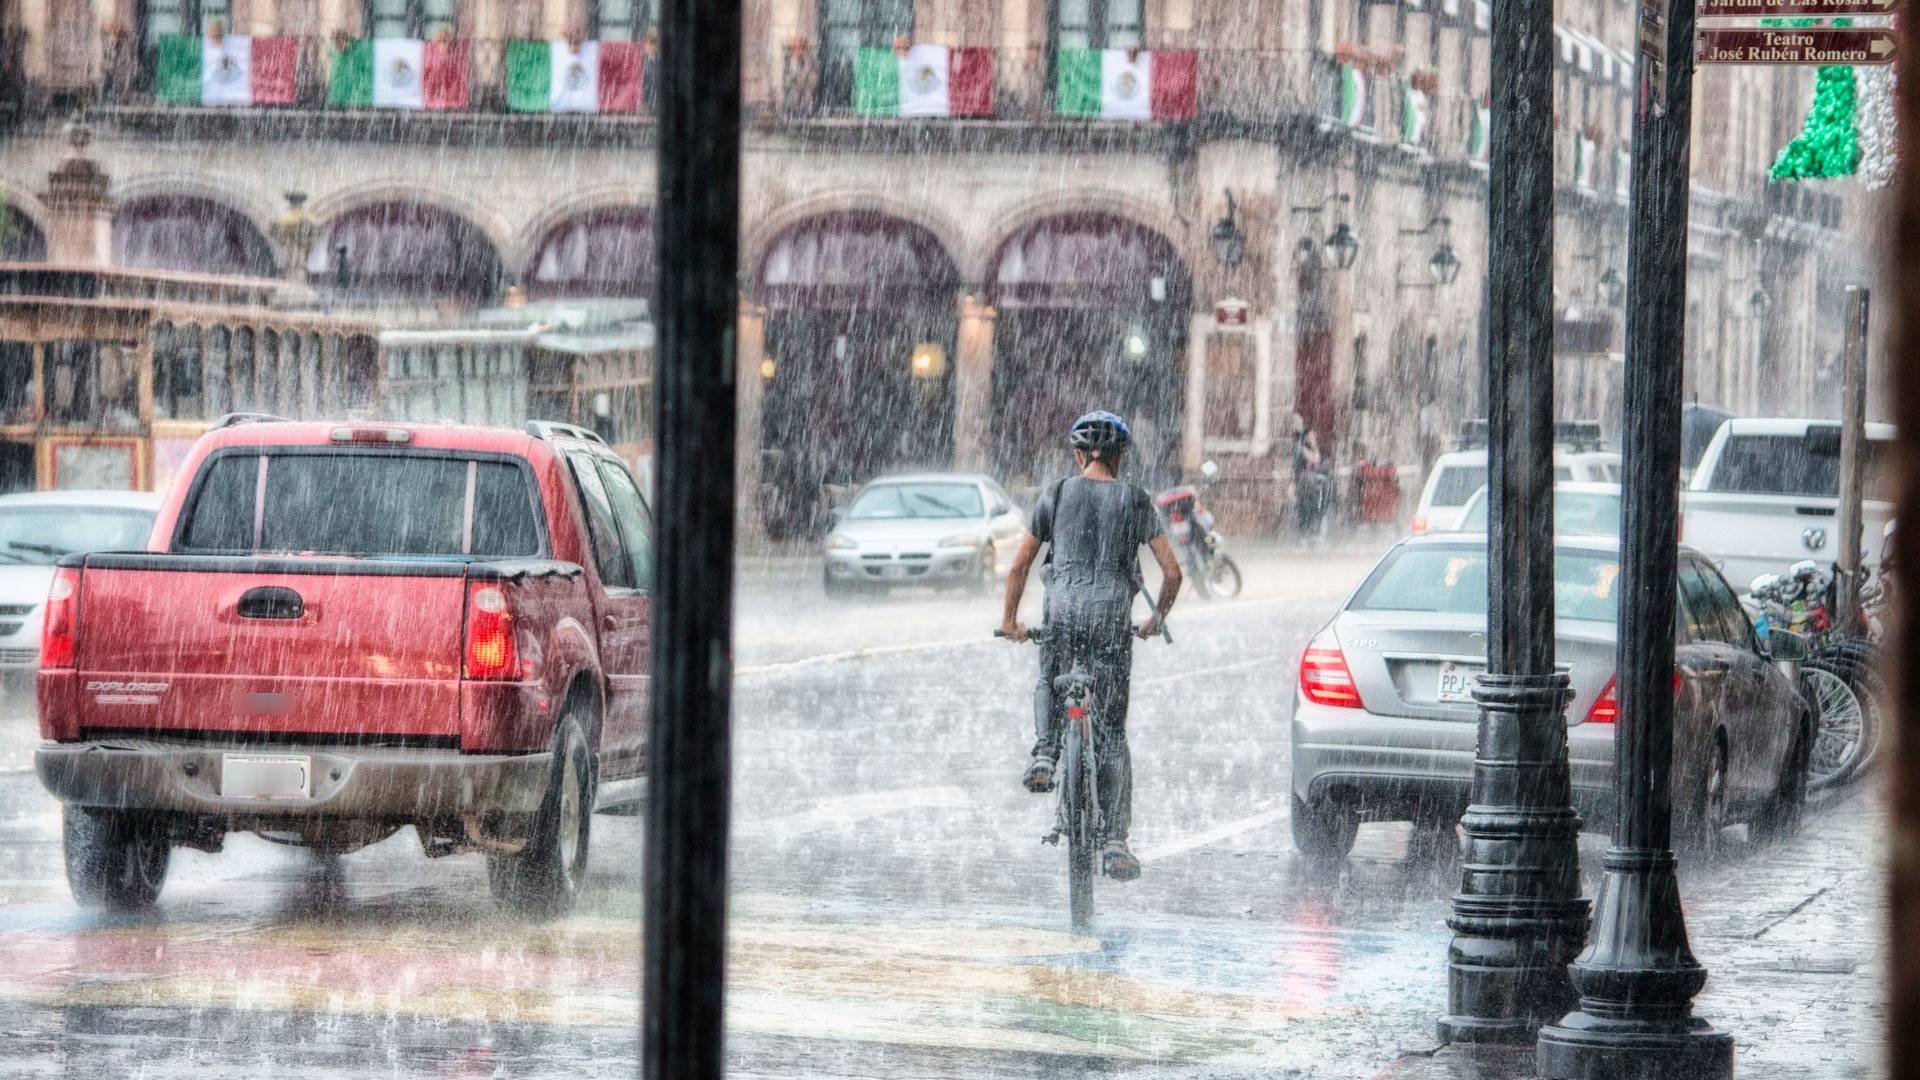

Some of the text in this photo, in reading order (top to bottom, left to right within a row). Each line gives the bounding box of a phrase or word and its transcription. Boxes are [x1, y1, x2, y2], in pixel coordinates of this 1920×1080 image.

[1763, 32, 1814, 46] Teatro
[1710, 46, 1867, 60] José Rubén Romero
[86, 681, 169, 692] EXPLORER
